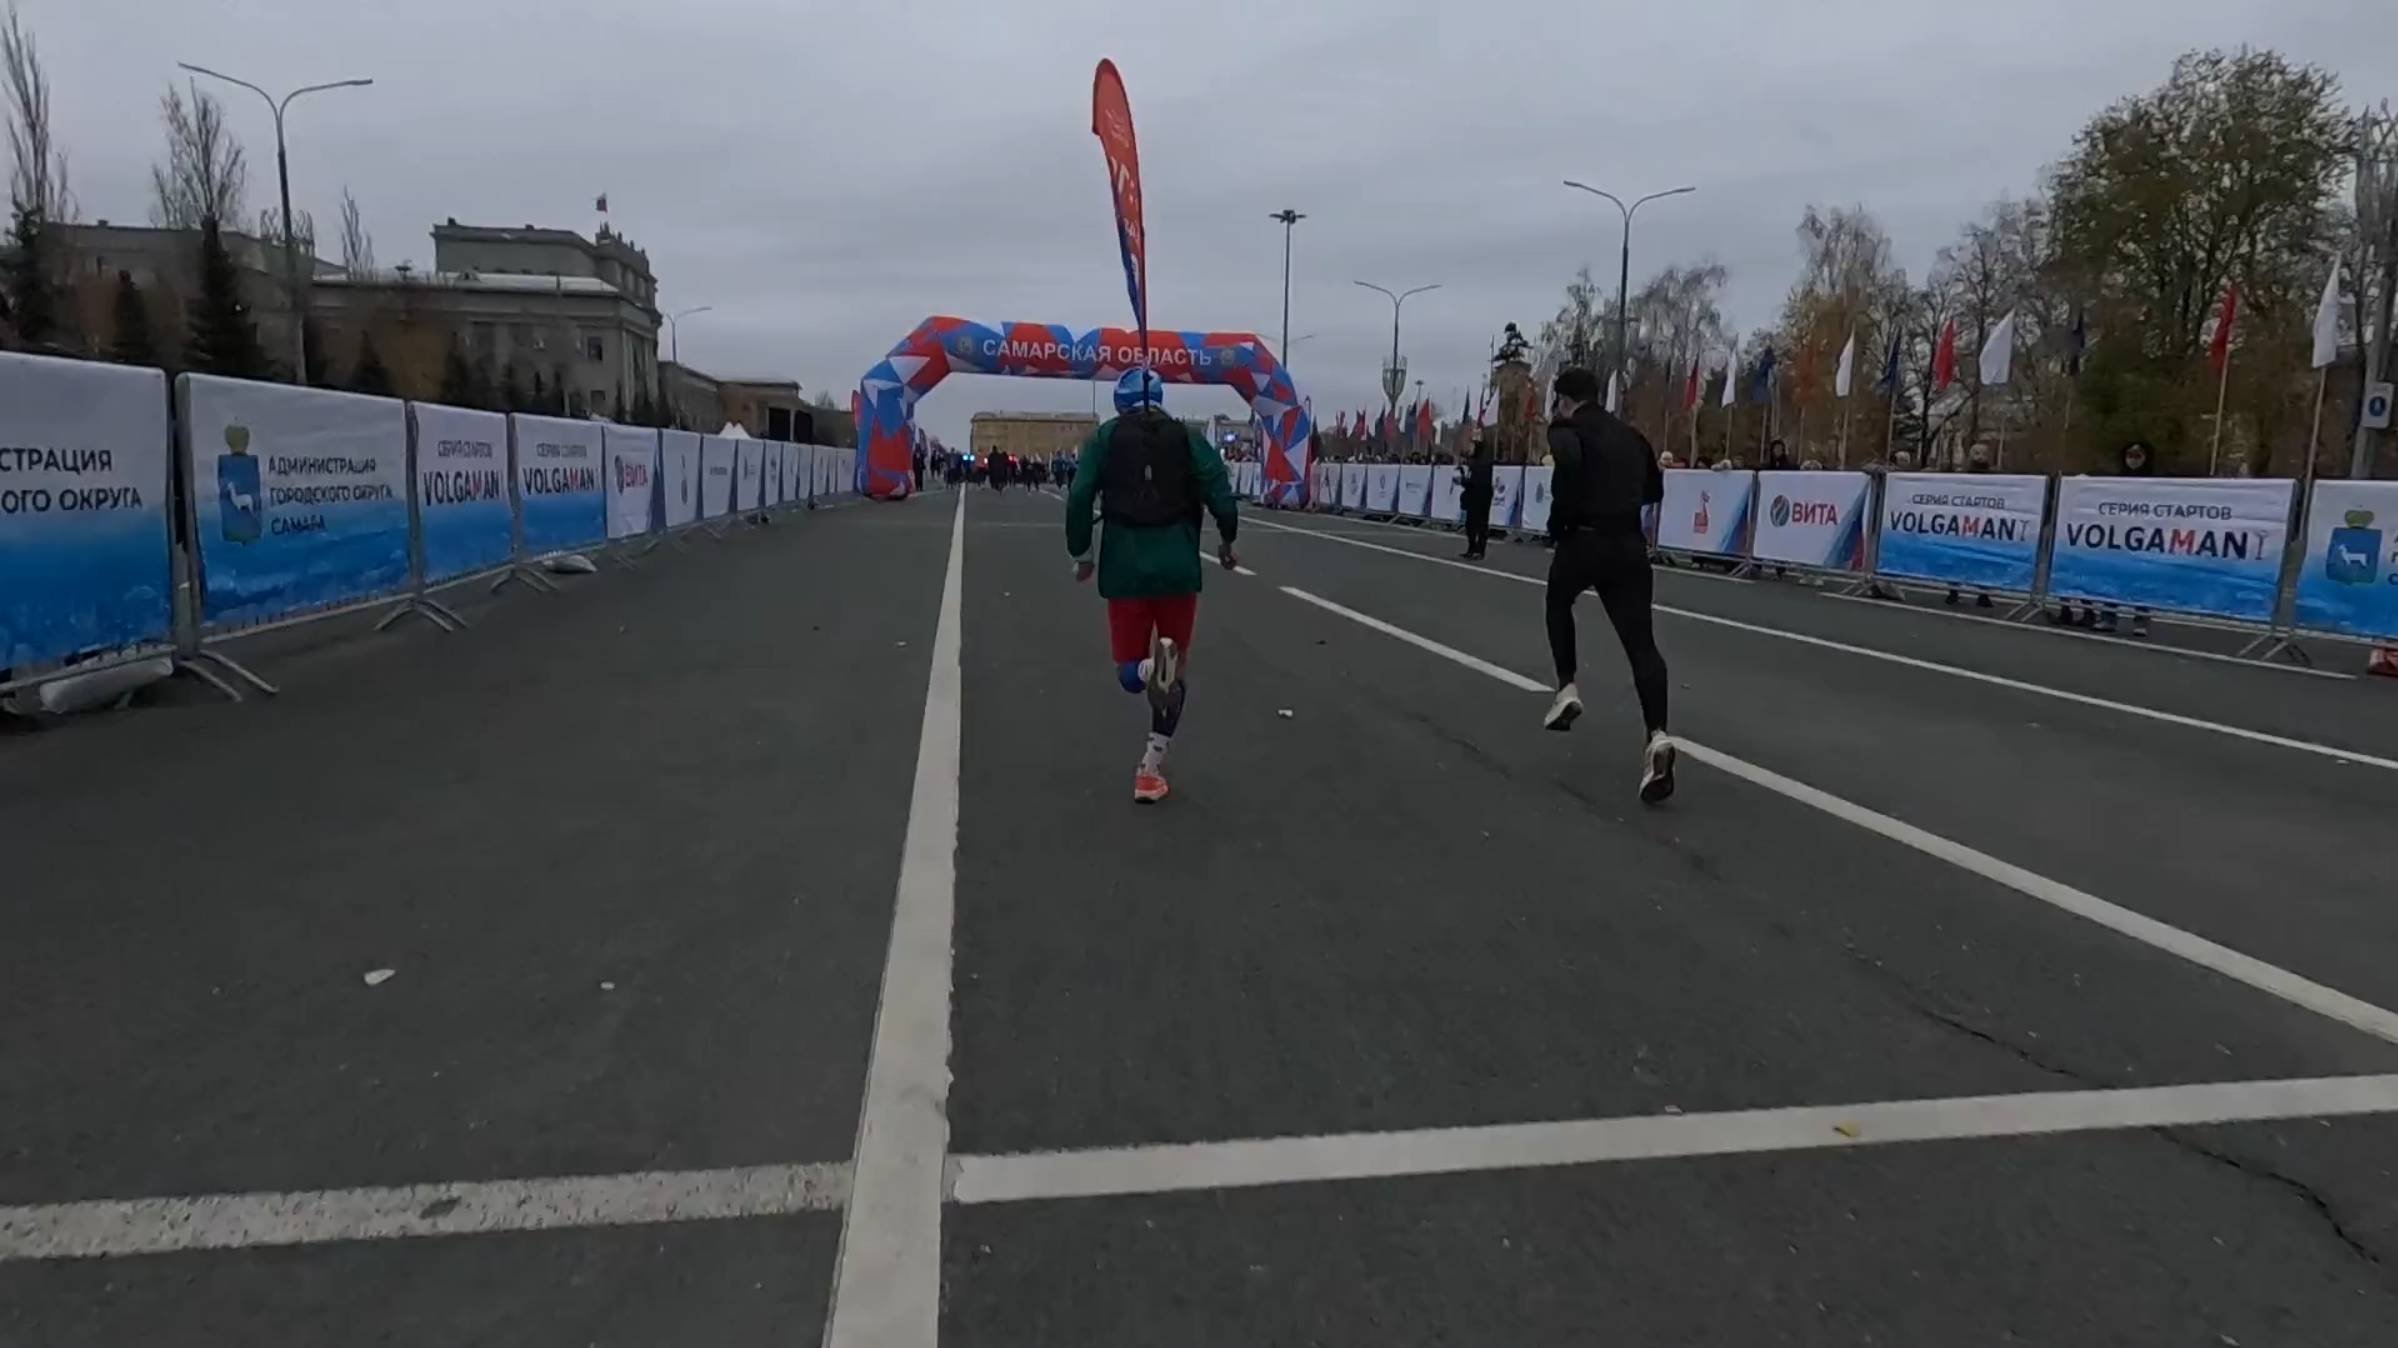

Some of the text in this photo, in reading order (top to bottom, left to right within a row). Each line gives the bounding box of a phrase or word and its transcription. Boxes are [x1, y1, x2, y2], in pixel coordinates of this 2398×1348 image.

[983, 339, 1212, 366] САМАРСКАЯ ОБЛАСТЬ
[0, 447, 112, 475] СТРАЦИЯ
[423, 470, 499, 507] VOLGAMAN
[522, 466, 595, 495] VOLGAMAN
[59, 487, 143, 511] ОКРУГА
[1912, 493, 2006, 510] СЕРИЯ СТАРТОВ
[2099, 502, 2233, 521] СЕРИЯ СТАРТОВ
[1791, 502, 1838, 526] ВИТА
[1890, 510, 2017, 541] VOLGAMAN
[2067, 522, 2249, 560] VOLGAMAN
